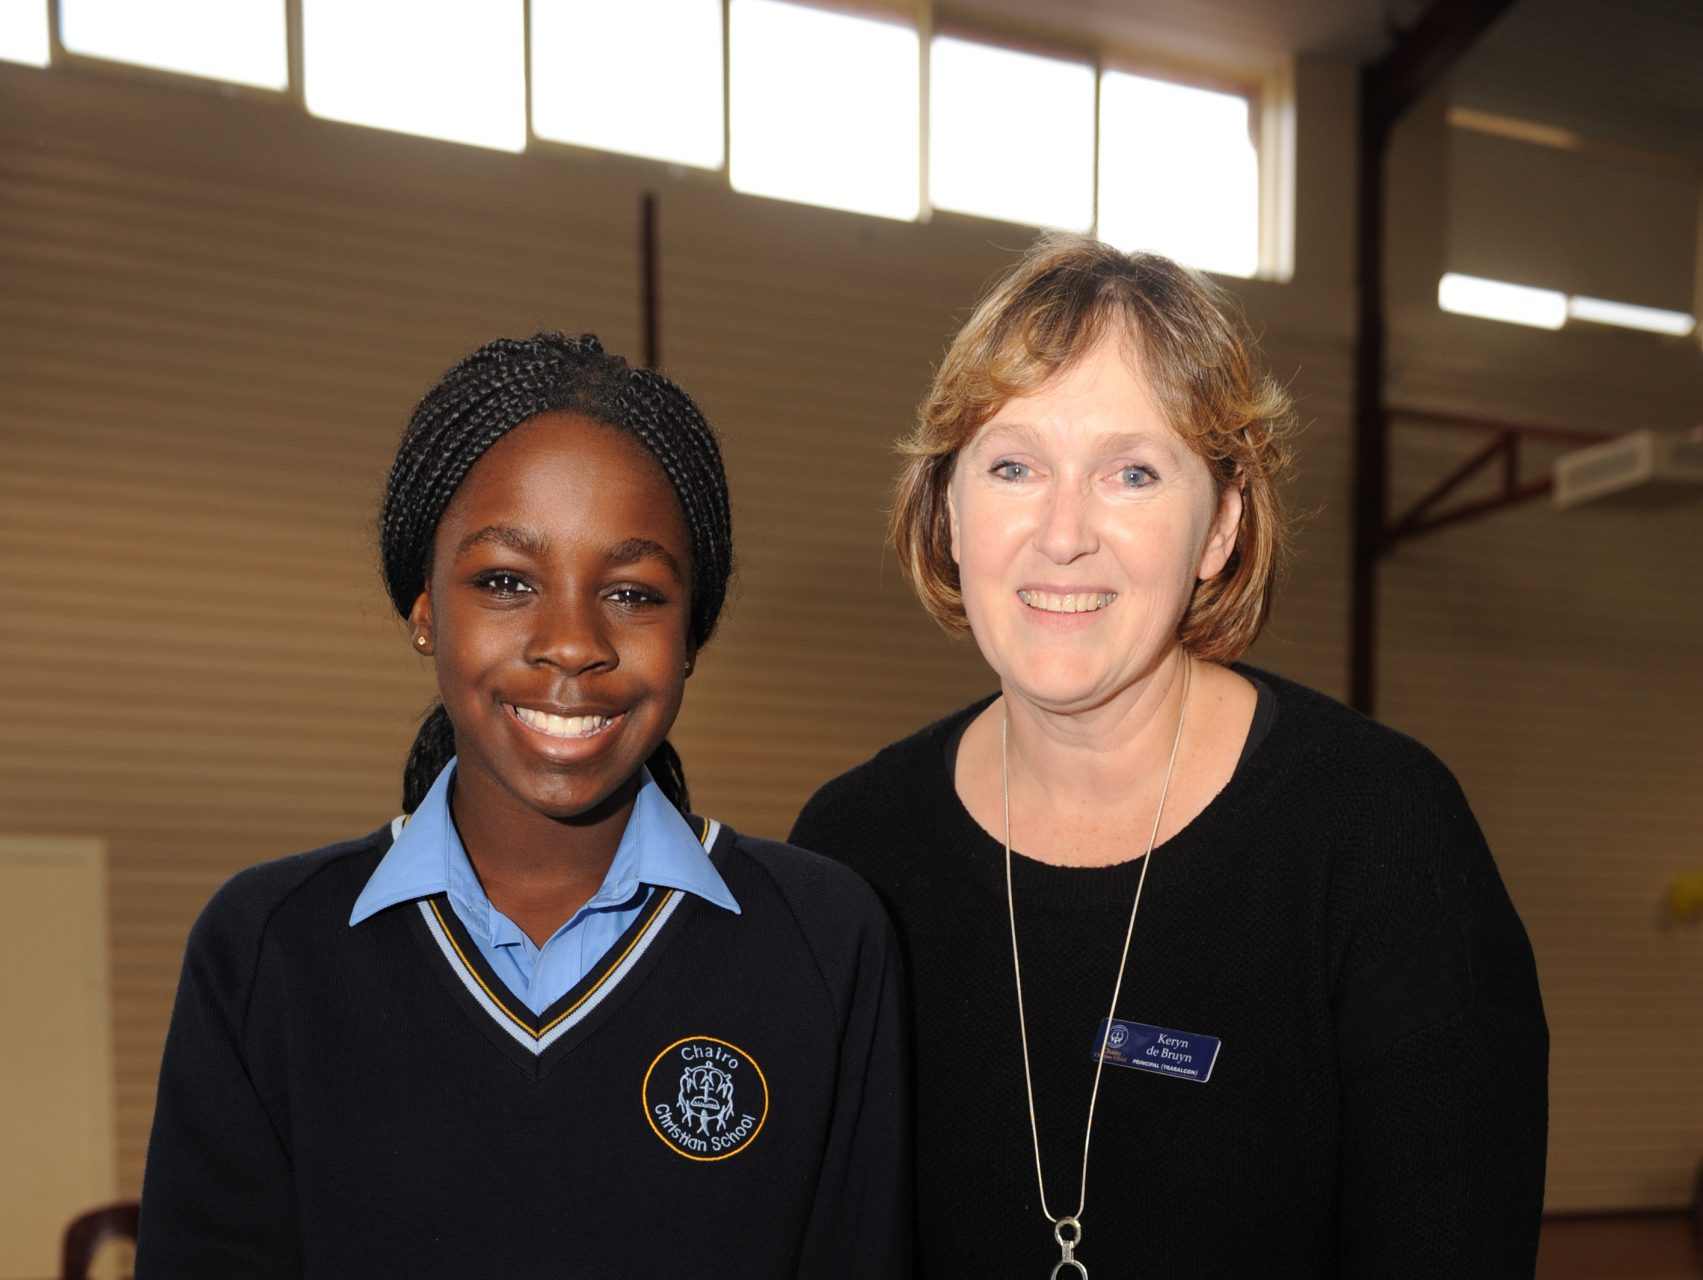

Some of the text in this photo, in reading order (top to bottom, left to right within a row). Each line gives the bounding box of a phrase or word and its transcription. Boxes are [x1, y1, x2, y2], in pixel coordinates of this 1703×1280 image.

[1157, 1033, 1189, 1049] Keryn
[681, 1045, 739, 1070] Chairo
[1146, 1045, 1192, 1063] de Bruyn
[1132, 1058, 1160, 1069] PRINCIPAL
[654, 1103, 757, 1152] Christian School
